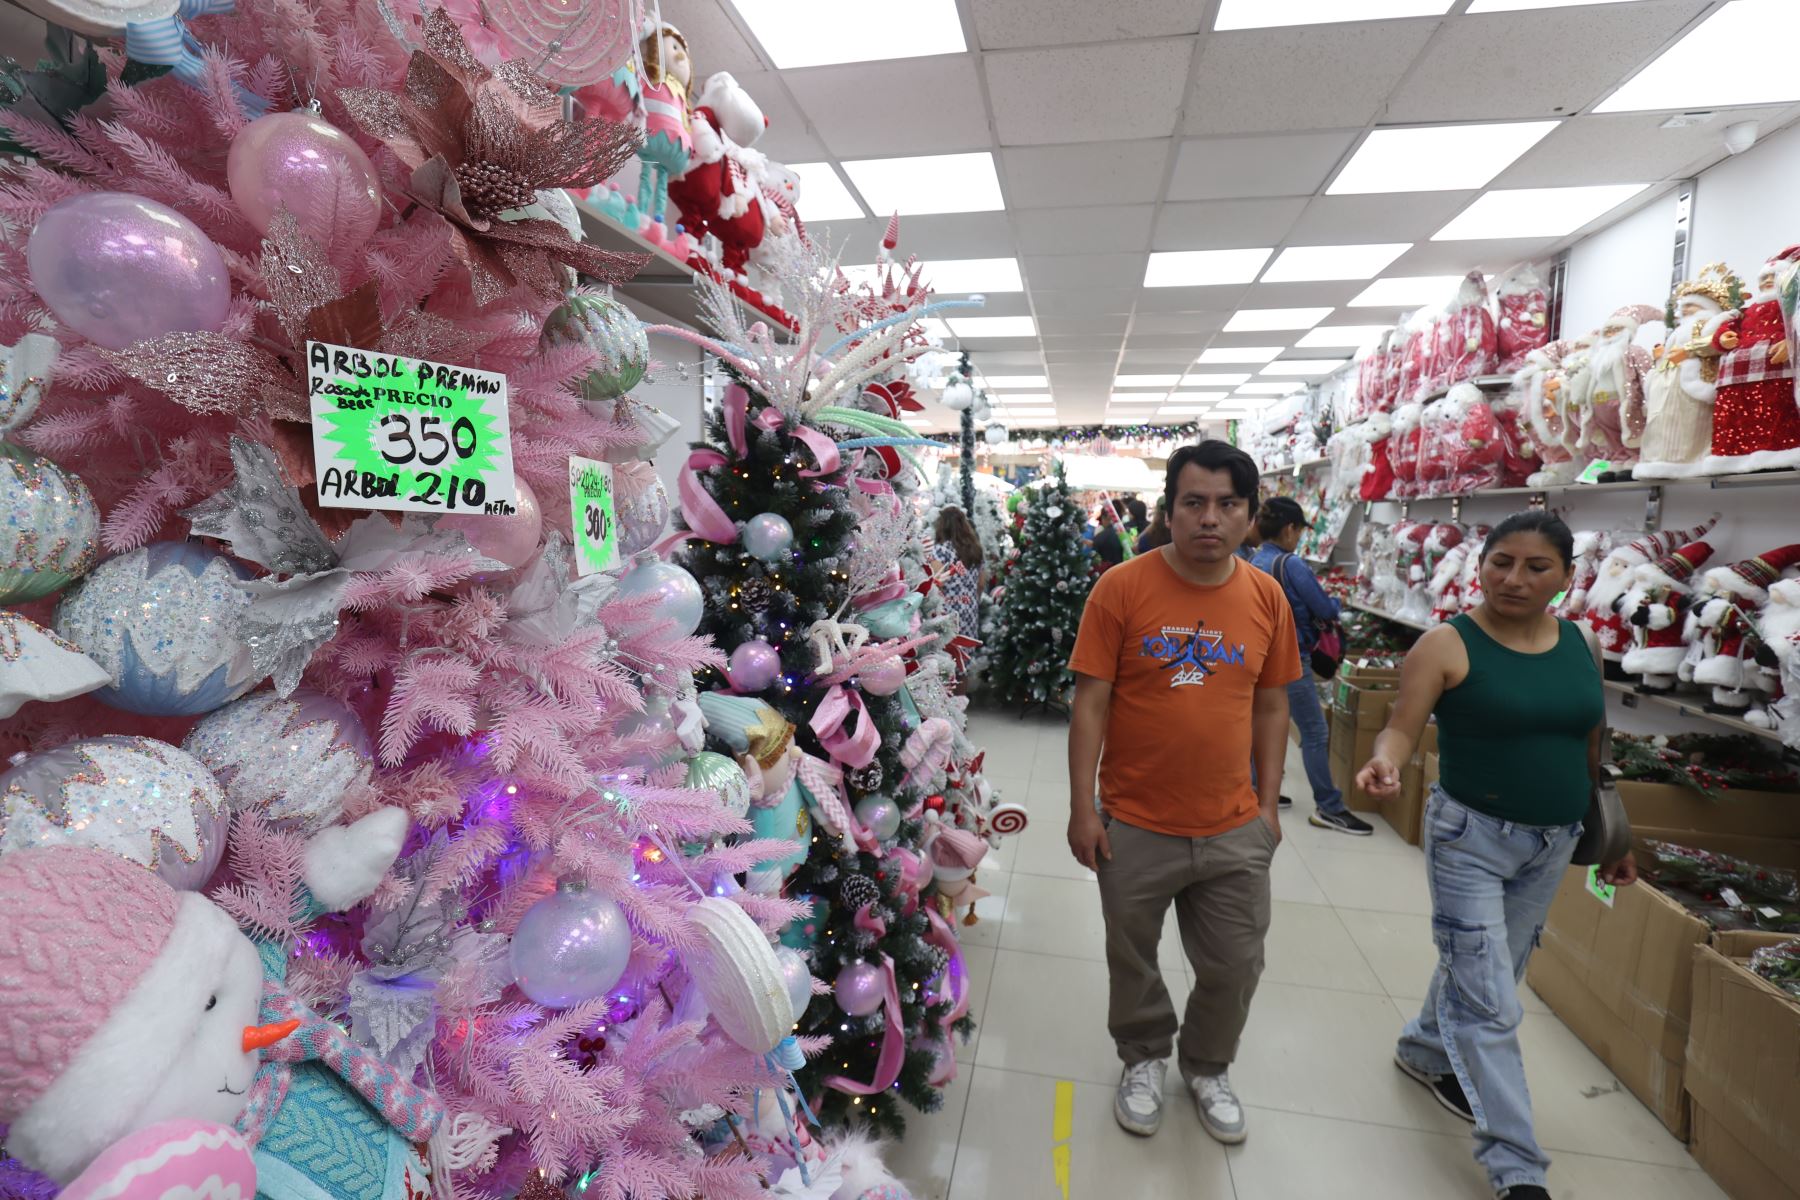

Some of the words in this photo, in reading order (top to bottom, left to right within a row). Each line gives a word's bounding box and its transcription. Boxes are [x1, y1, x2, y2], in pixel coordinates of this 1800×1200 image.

[310, 342, 404, 379] ARBOL
[373, 387, 453, 409] PRECIO
[380, 414, 477, 465] 350
[1138, 635, 1245, 665] JORDAN
